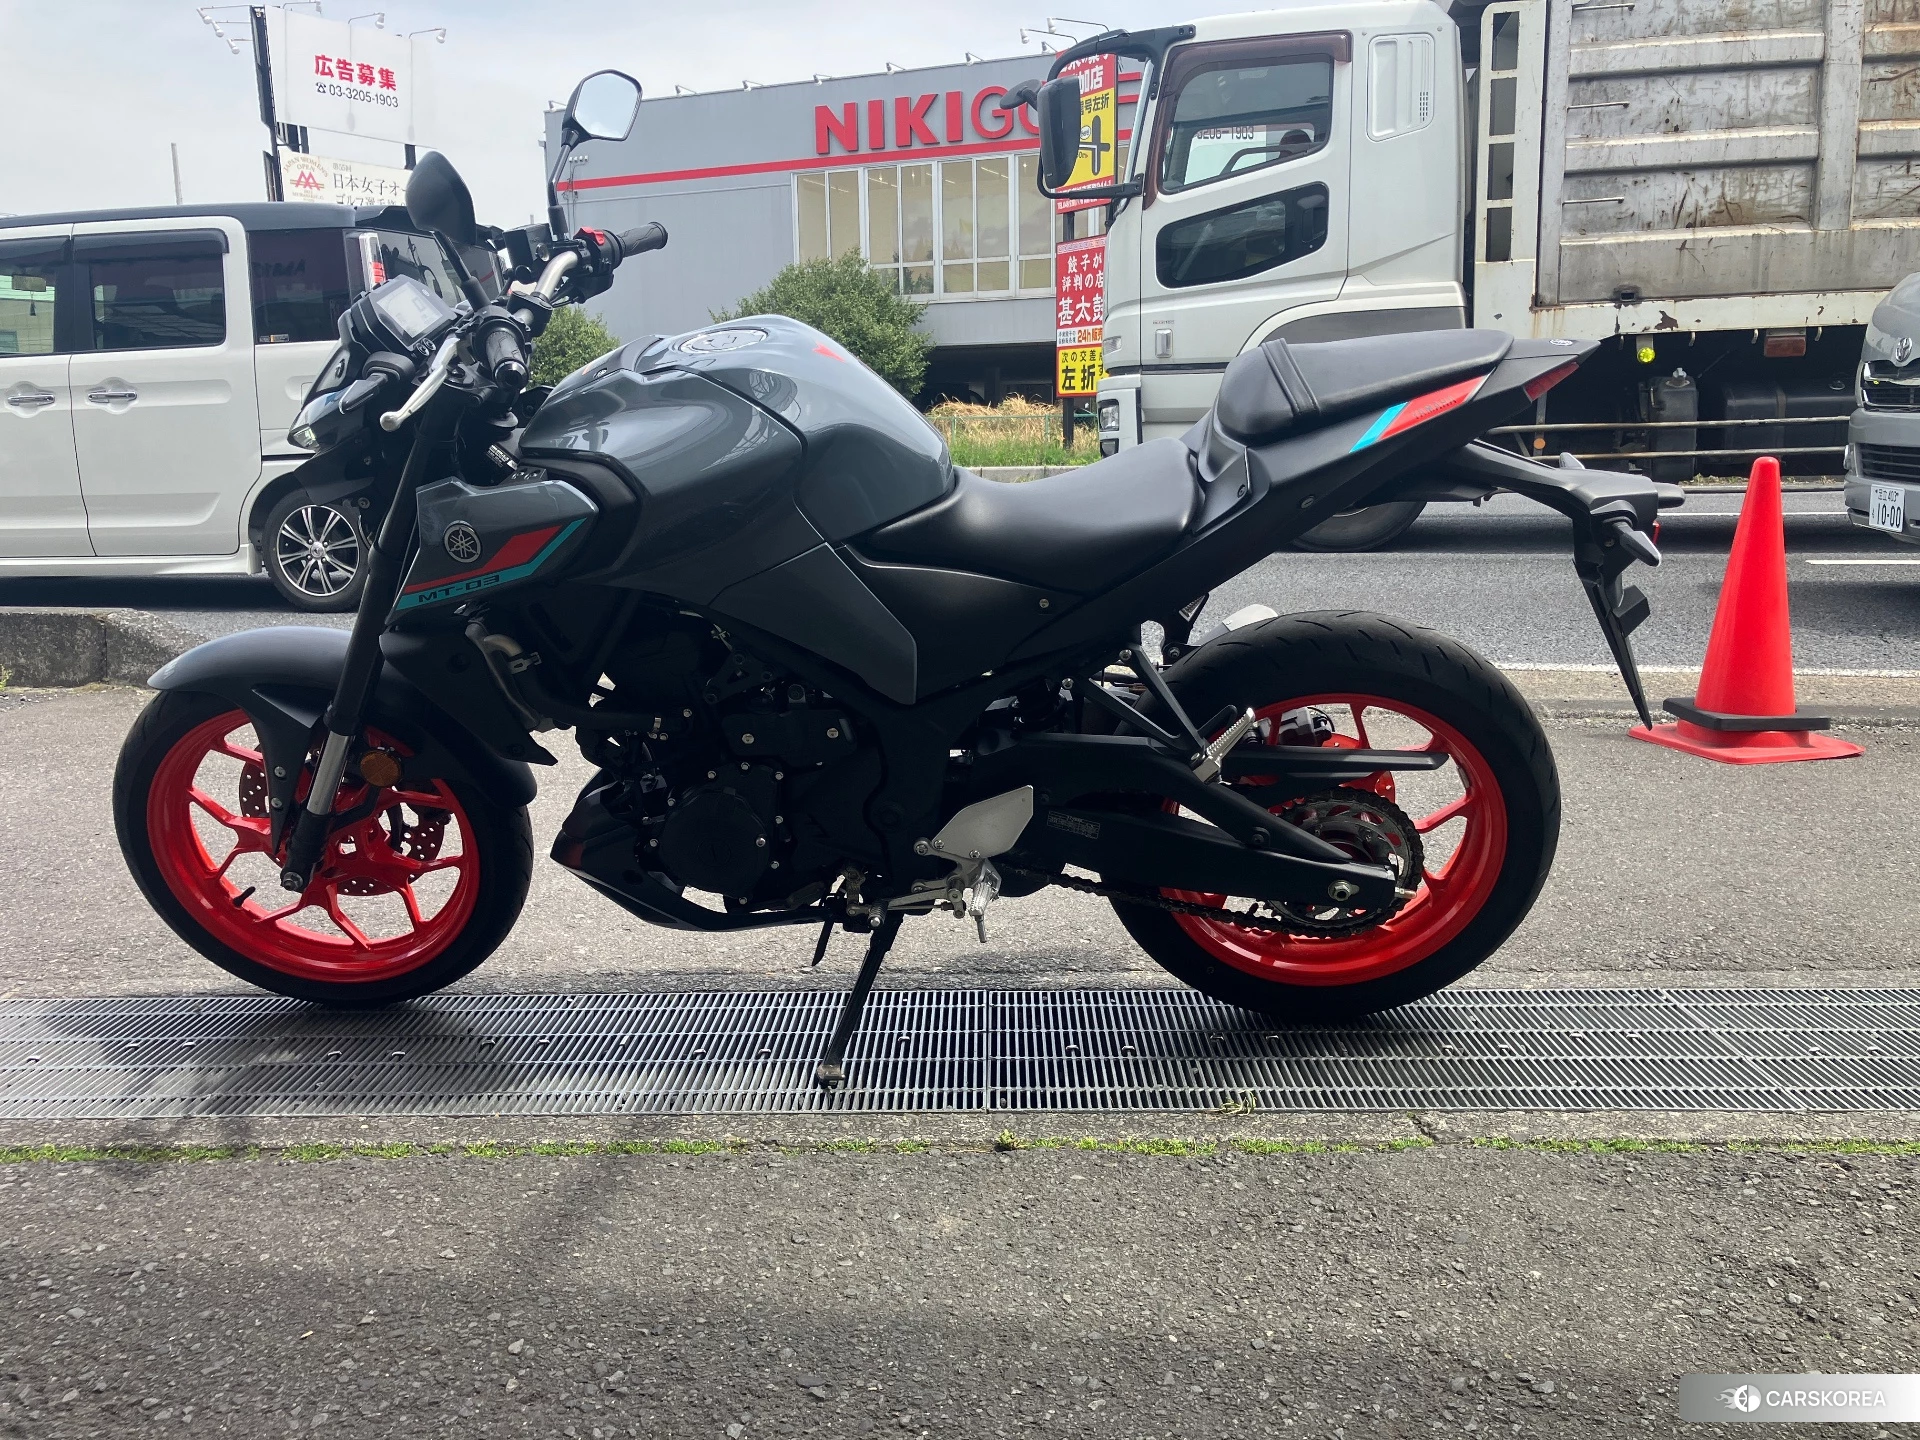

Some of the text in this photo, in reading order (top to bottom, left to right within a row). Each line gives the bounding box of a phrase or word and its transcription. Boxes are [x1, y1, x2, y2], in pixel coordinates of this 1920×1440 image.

[314, 54, 397, 92] 広告募集
[328, 83, 399, 108] 03-3205-1903
[1068, 253, 1103, 274] 餃子が
[1062, 270, 1104, 293] 評判の店
[418, 574, 500, 603] MT-03
